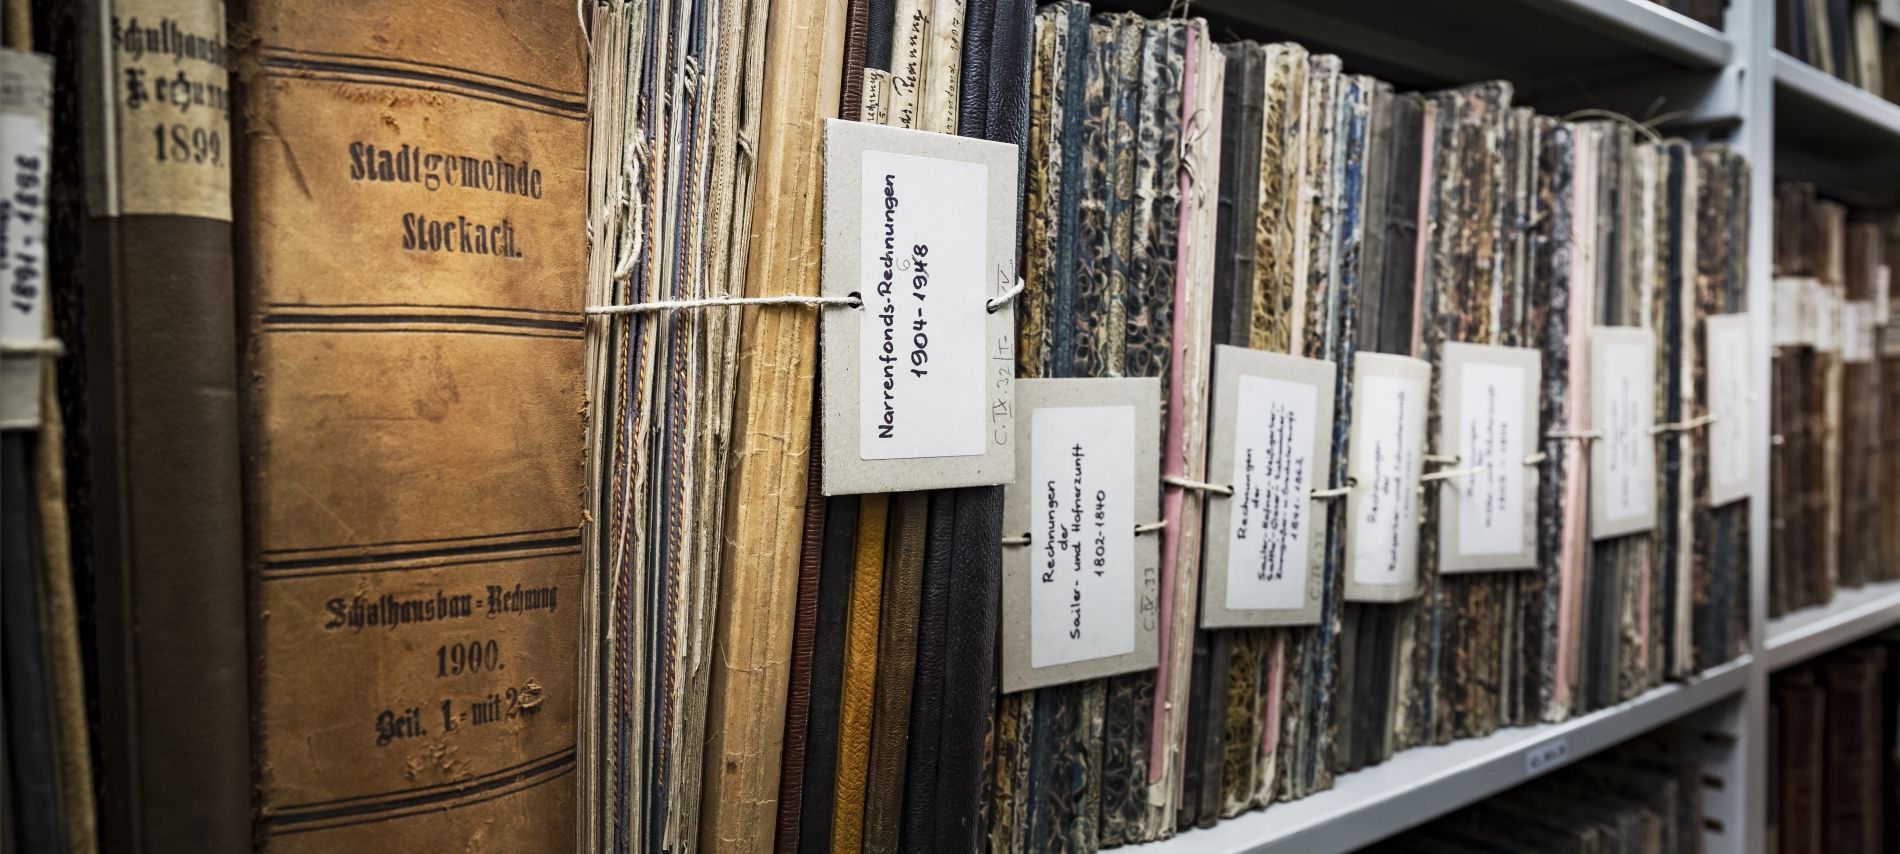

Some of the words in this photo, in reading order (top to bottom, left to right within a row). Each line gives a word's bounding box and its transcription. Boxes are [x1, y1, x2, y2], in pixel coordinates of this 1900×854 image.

[154, 122, 225, 168] 1899.
[349, 141, 543, 200] Stadtgemeinde
[402, 212, 523, 258] Stockach.
[877, 174, 899, 439] Narrenfonds-Rechnungen
[1071, 443, 1085, 533] Hafnerzunft
[1237, 448, 1255, 540] Rechnungen
[1042, 481, 1059, 583] Rechnungen
[1057, 524, 1068, 550] der
[1074, 541, 1082, 571] und
[1094, 489, 1106, 577] 1802-1840
[1069, 580, 1081, 640] Sailer-
[436, 639, 506, 679] 1900.
